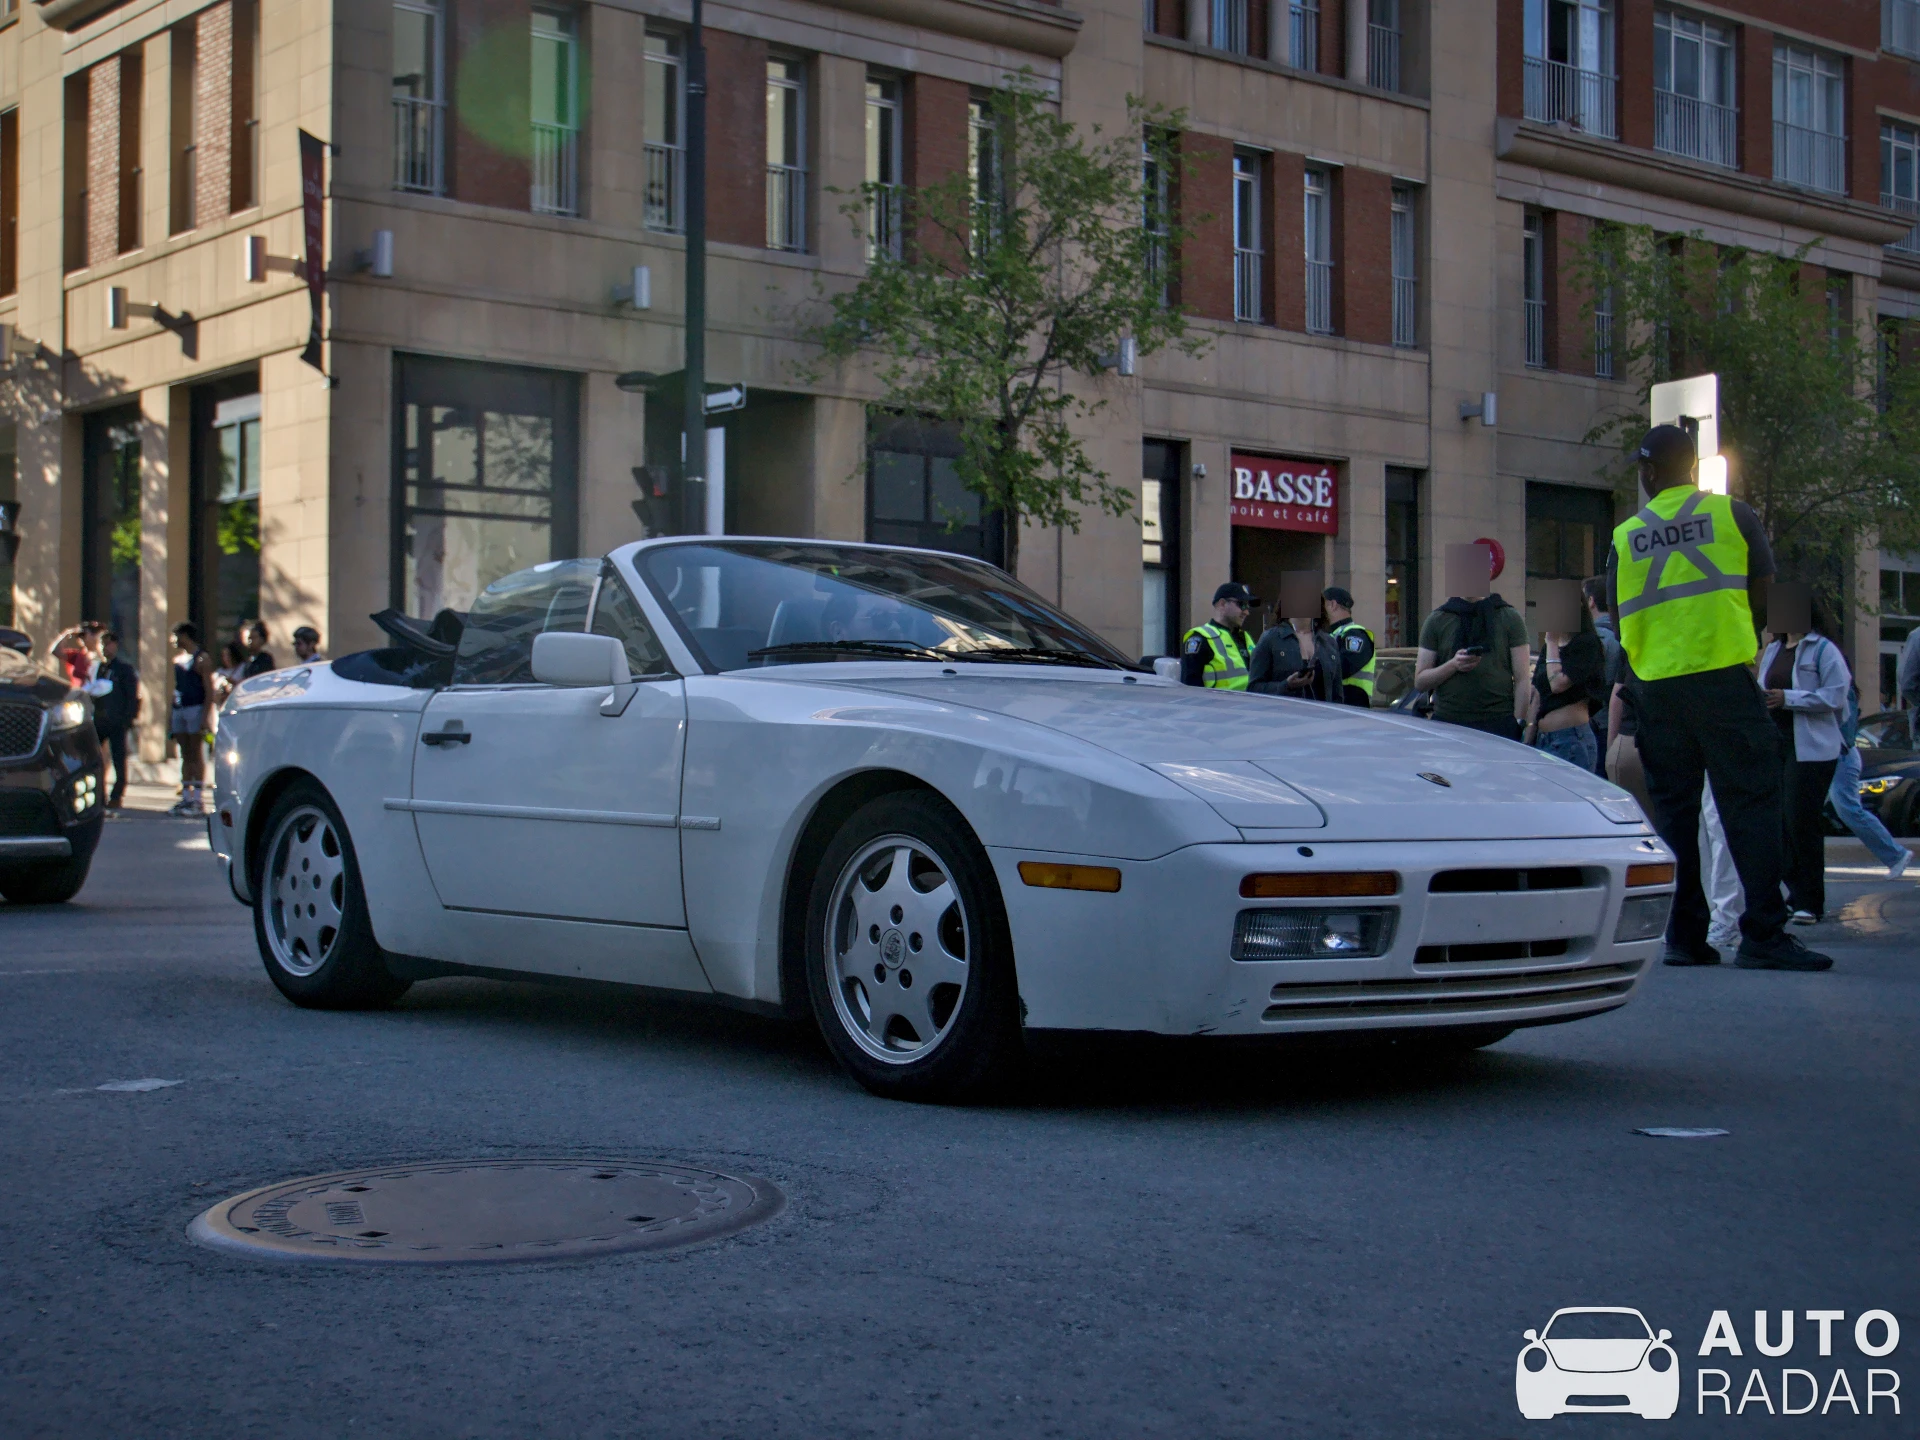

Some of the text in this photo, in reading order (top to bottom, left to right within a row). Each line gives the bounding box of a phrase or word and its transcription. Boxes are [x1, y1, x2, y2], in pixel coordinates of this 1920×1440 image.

[1234, 468, 1332, 508] BASSÉ
[1230, 504, 1329, 524] noix et café
[1633, 519, 1708, 553] CADET
